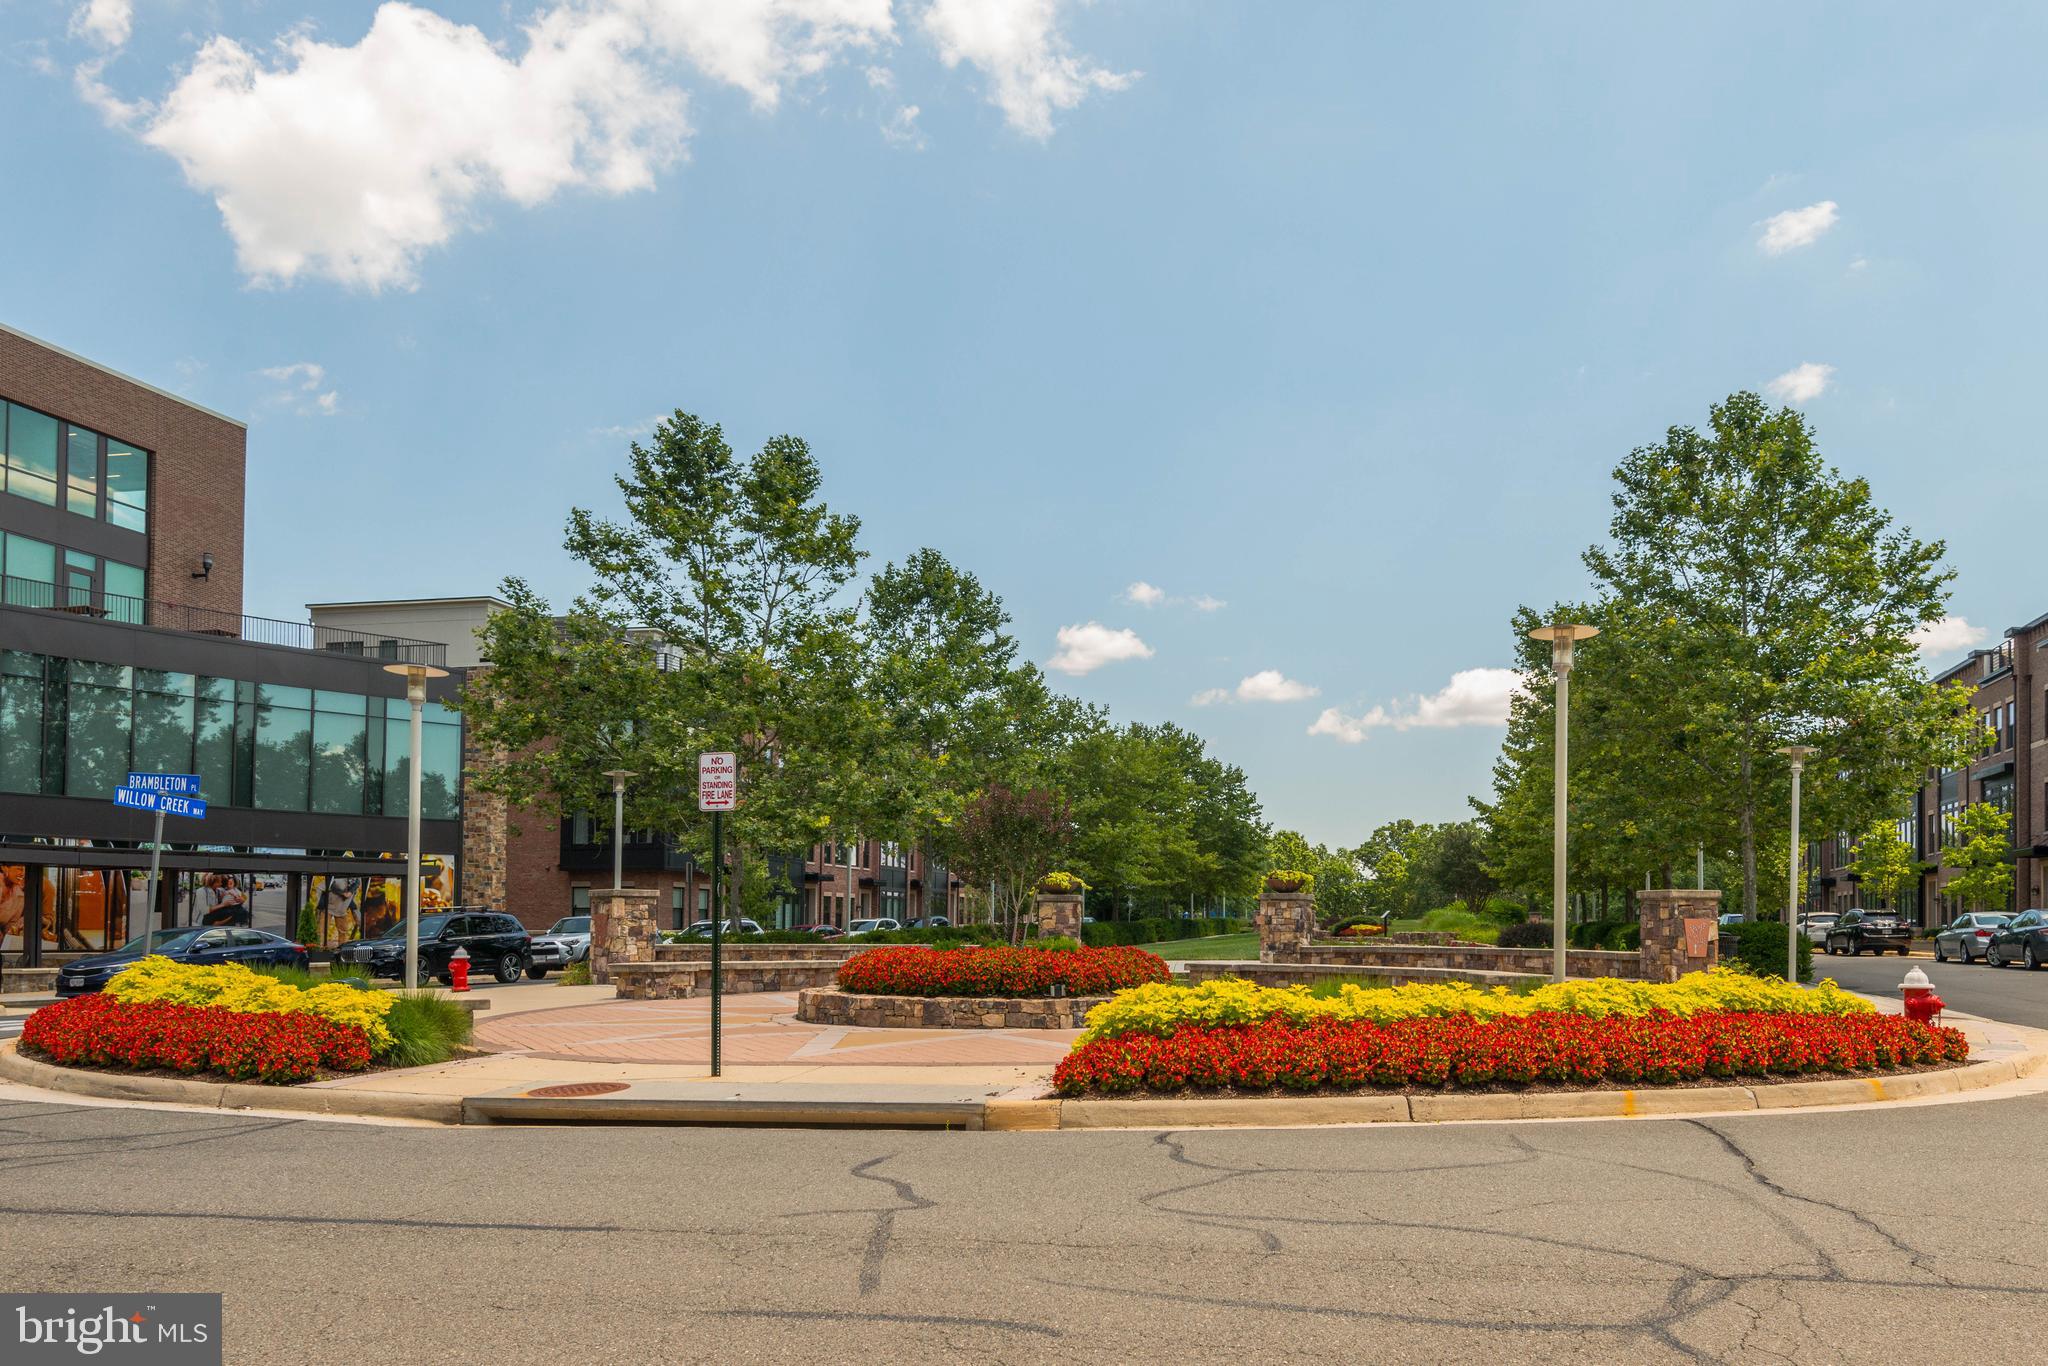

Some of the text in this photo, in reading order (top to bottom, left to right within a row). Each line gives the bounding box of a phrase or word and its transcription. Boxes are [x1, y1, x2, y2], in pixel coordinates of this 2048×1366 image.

[711, 757, 723, 765] NO
[702, 766, 732, 774] PARKING
[129, 775, 197, 792] BRAMBLETON PL
[702, 781, 732, 789] STANDING
[702, 790, 732, 799] FIRE LANE
[117, 789, 204, 816] WILLOW CREEK WAY
